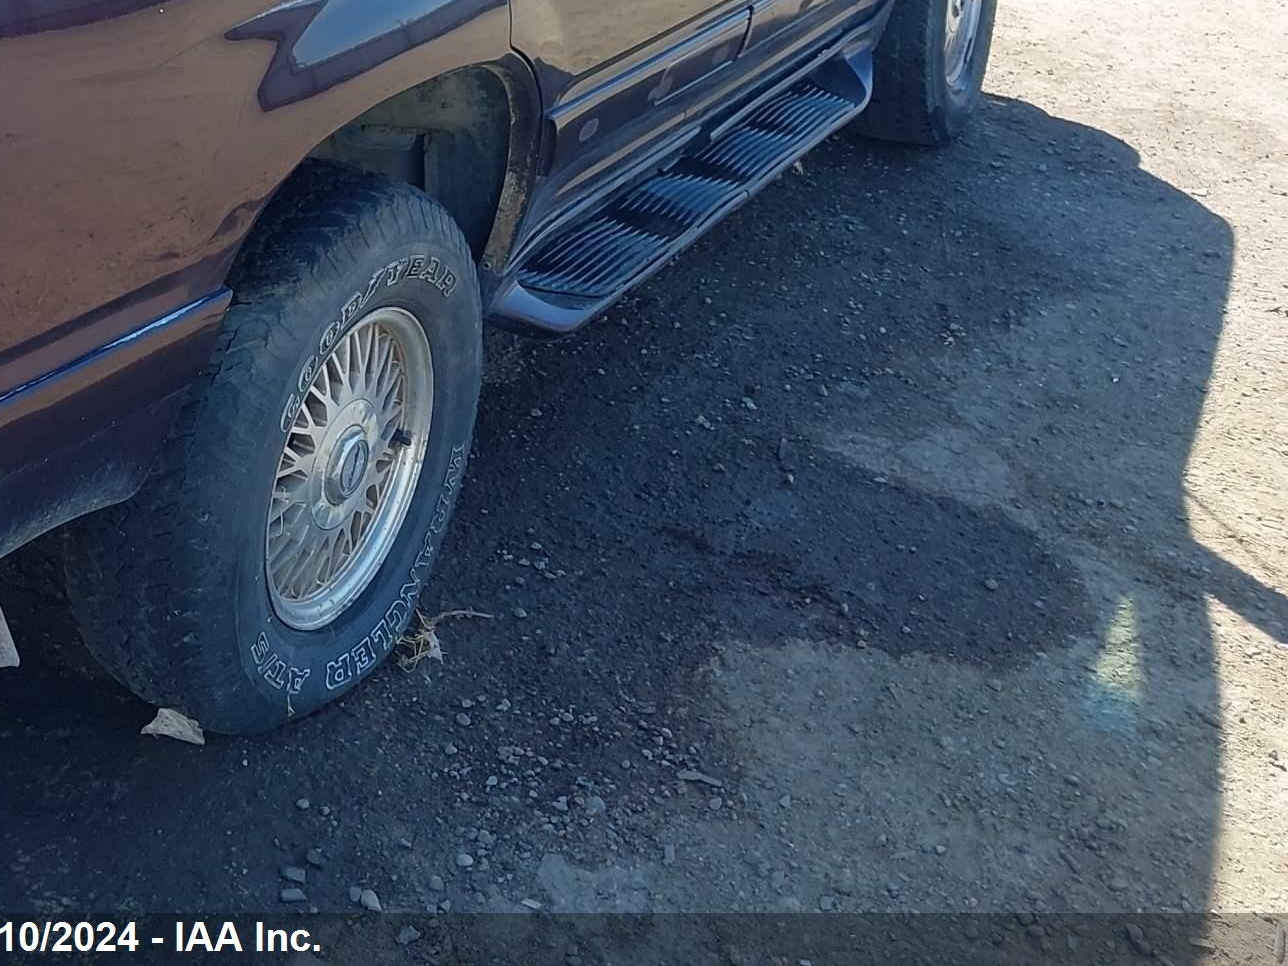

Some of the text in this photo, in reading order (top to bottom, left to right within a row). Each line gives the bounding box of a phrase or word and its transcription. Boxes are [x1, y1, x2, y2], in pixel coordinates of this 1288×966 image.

[280, 254, 458, 433] GOODYEAR
[250, 443, 466, 694] WRANGLER AT/S
